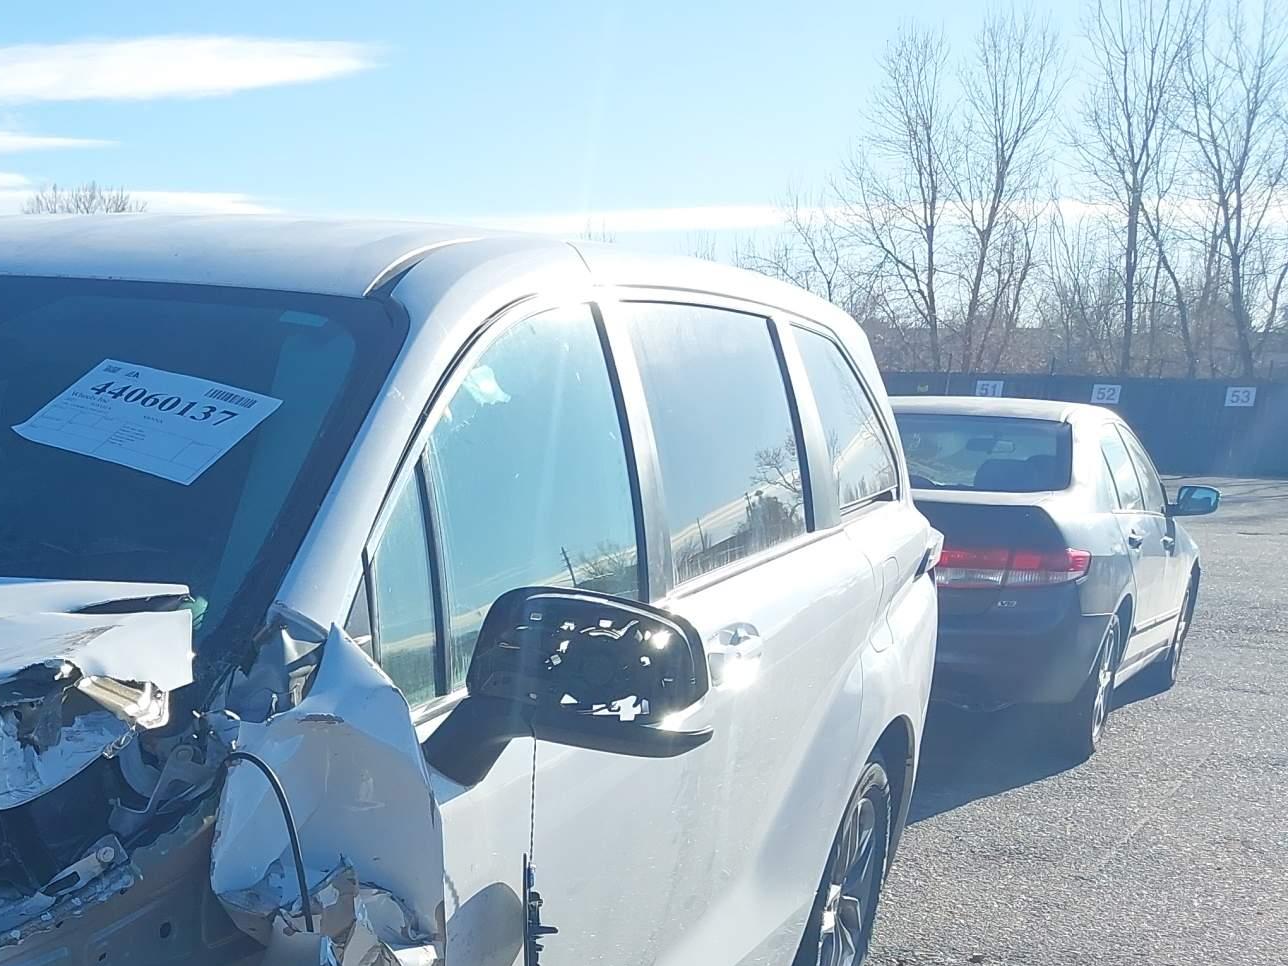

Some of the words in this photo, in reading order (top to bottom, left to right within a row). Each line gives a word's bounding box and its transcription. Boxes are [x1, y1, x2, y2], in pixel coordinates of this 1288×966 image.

[980, 383, 998, 396] 51
[1096, 387, 1116, 401] 52
[90, 381, 240, 426] 44060137
[1231, 390, 1251, 404] 53
